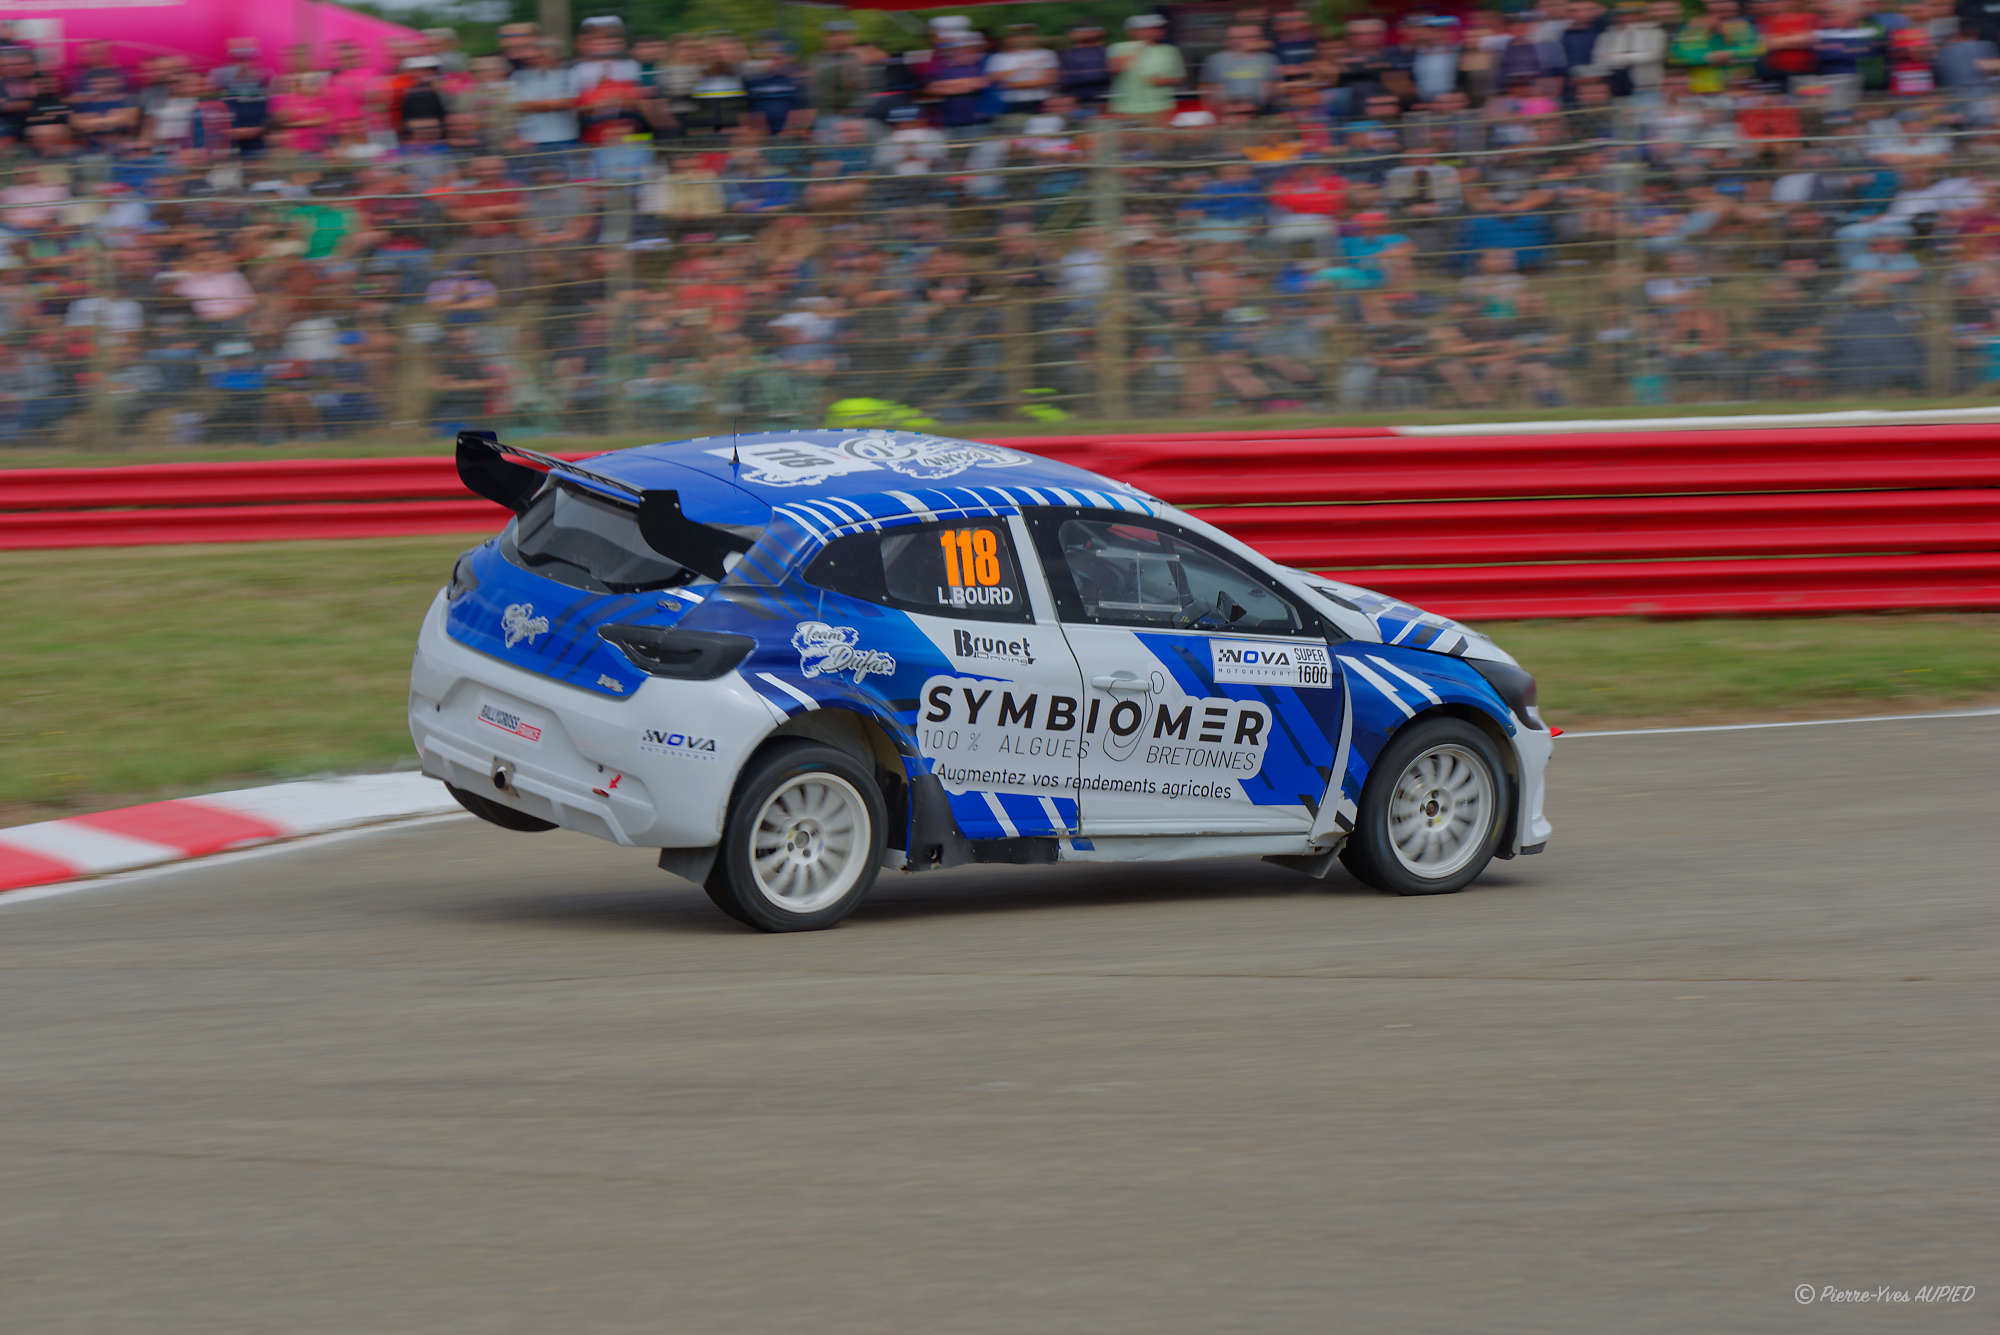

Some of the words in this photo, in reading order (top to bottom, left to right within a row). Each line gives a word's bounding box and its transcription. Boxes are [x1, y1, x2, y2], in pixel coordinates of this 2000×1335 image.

[940, 529, 1001, 587] 118
[938, 586, 1013, 605] L.BOURD
[798, 622, 842, 644] Team
[953, 629, 1031, 657] Brunet
[1219, 649, 1290, 666] NOVA
[1294, 648, 1326, 662] SUPER
[1218, 668, 1291, 677] MOTORSPORT
[1297, 665, 1328, 684] 1600
[926, 686, 1264, 745] SYMBIOMER
[642, 729, 716, 752] NOVA
[924, 730, 959, 750] 100
[967, 732, 982, 751] %
[998, 735, 1090, 759] ALGUES
[1146, 745, 1256, 771] BRETONNES
[937, 763, 1026, 785] Augmentez
[1032, 774, 1059, 787] vos
[1065, 774, 1156, 793] rendements
[1162, 779, 1231, 799] agricoles
